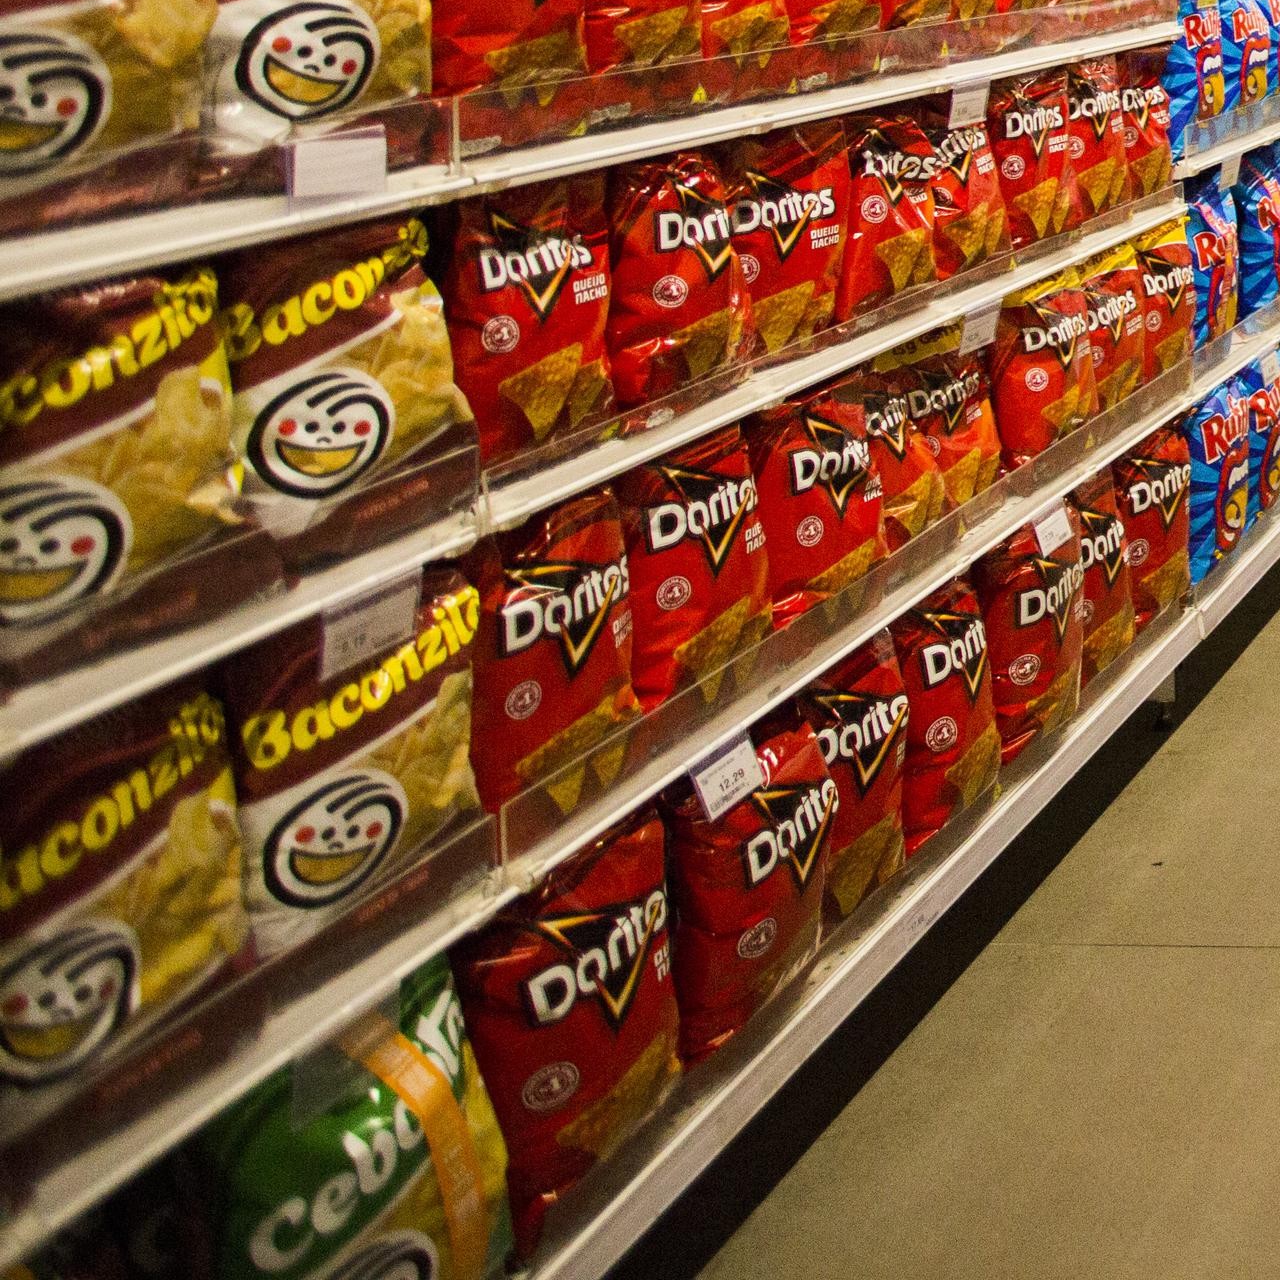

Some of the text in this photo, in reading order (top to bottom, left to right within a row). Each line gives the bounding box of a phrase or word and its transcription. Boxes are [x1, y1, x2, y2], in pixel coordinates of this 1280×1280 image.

[1183, 9, 1221, 50] Ruff
[1233, 6, 1270, 43] Ruff
[1005, 104, 1063, 139] Doritos
[658, 208, 730, 253] Dori
[733, 187, 835, 235] Doritos
[810, 224, 840, 241] QUEIJO
[477, 236, 592, 290] Doritos
[811, 235, 840, 250] NACHO
[573, 273, 606, 291] QUEIJO
[575, 287, 608, 305] NACHO
[1022, 312, 1086, 352] Doritos
[792, 439, 869, 495] Dori
[1131, 463, 1191, 513] Dorito
[1081, 518, 1125, 569] Dori
[503, 556, 630, 653] Doritos
[1020, 560, 1083, 626] Dorito
[923, 620, 986, 686] Dorit
[818, 695, 908, 764] Dorito
[748, 779, 839, 885] Dorito
[527, 890, 667, 1024] Dorito
